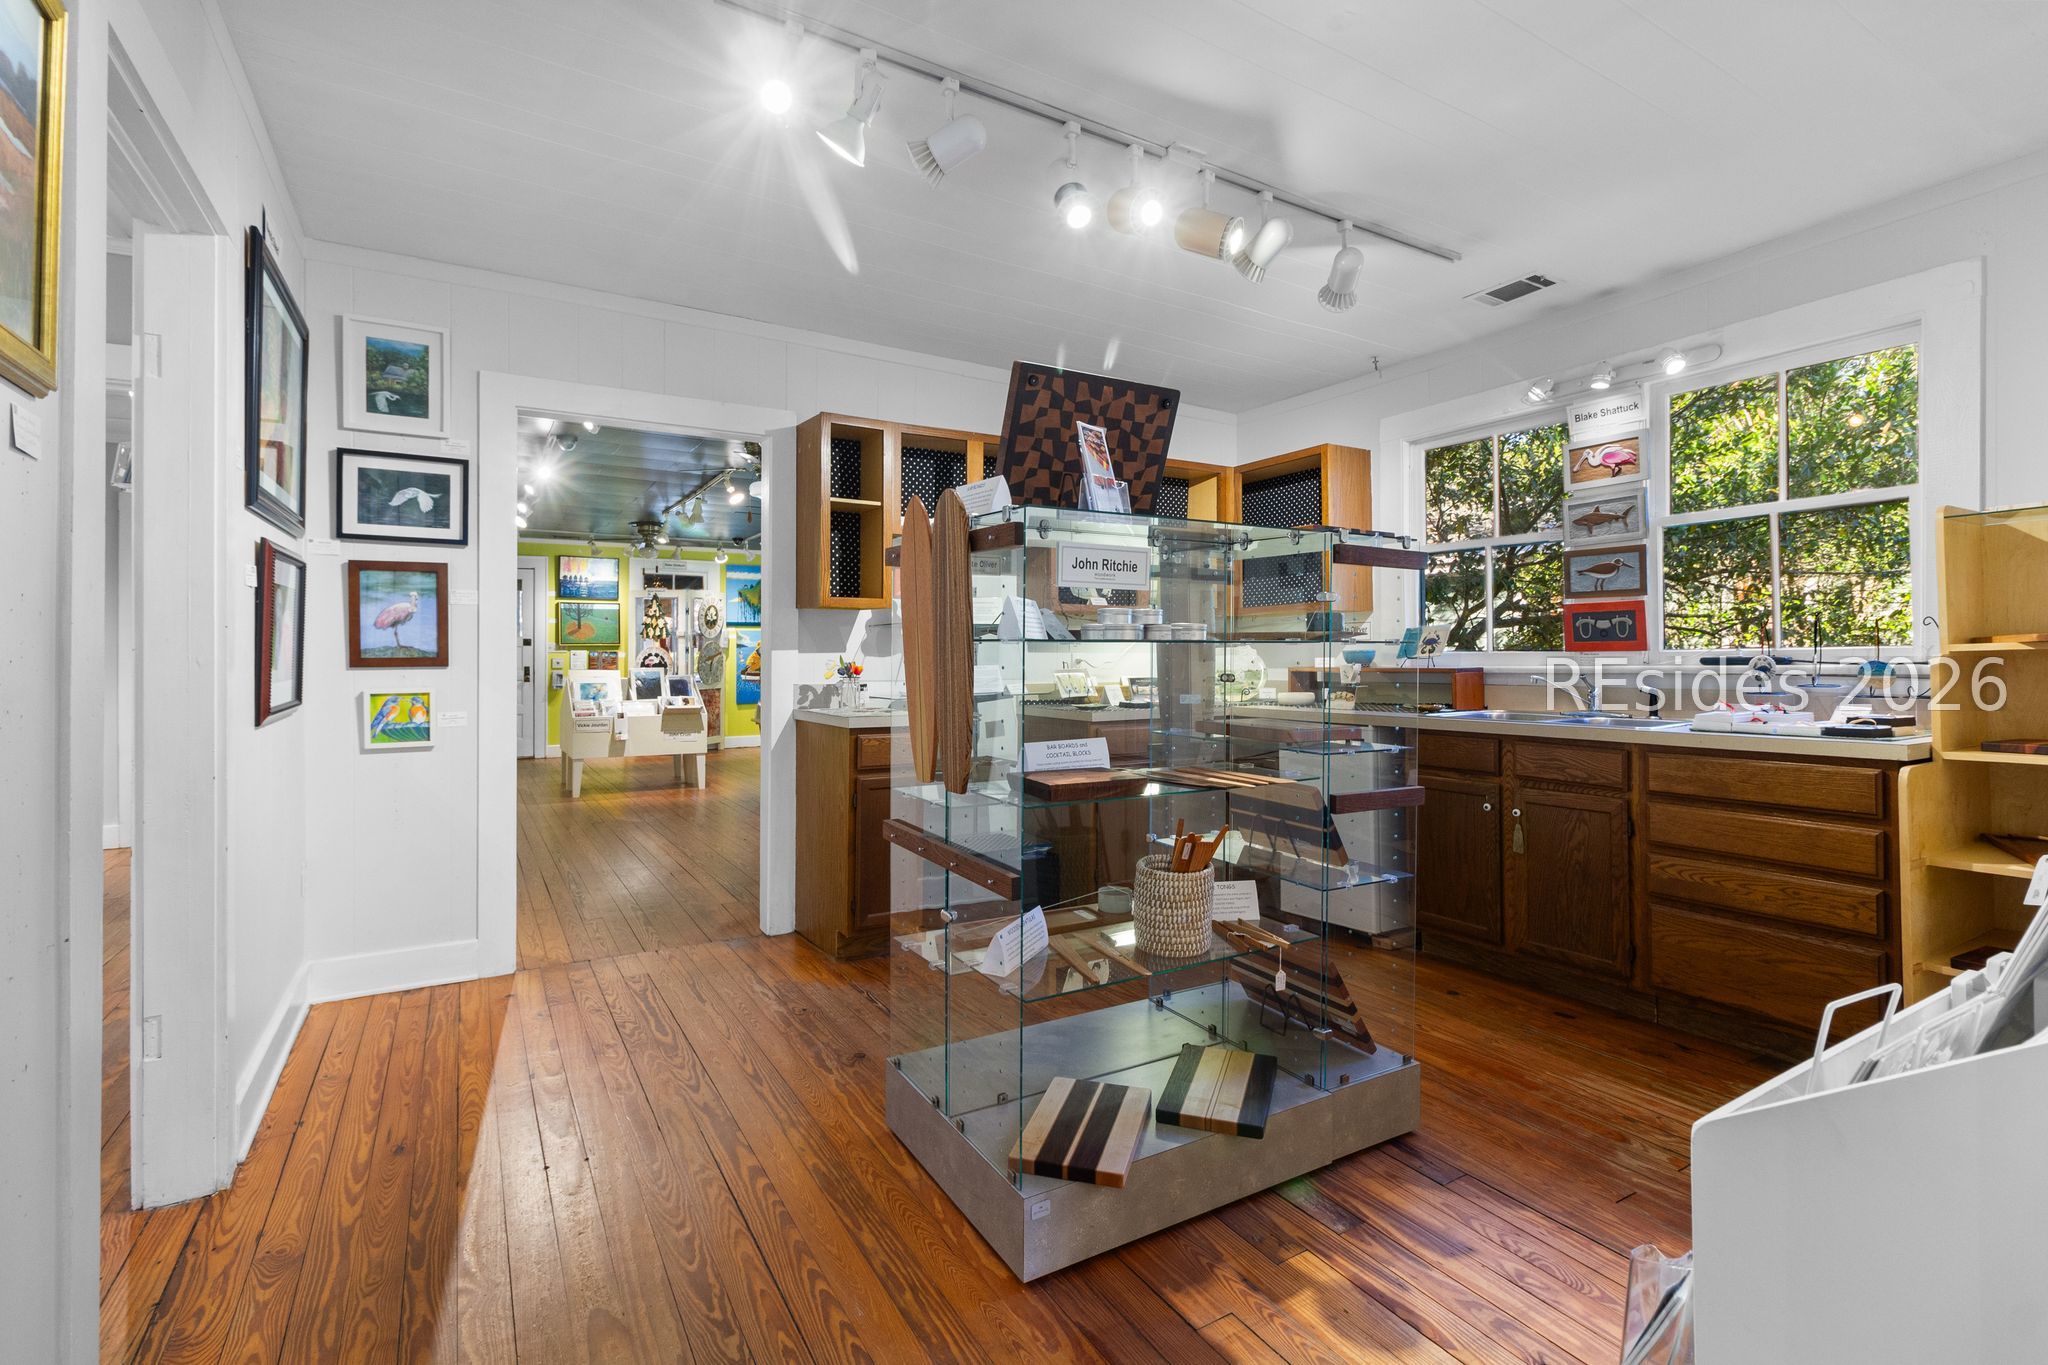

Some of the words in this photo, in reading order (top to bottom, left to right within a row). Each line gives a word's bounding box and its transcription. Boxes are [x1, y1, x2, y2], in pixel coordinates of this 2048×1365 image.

[1574, 411, 1598, 423] Blake
[1600, 401, 1640, 417] Shattuck
[979, 559, 998, 569] Oliver
[1071, 556, 1099, 571] John
[1102, 558, 1138, 573] Ritchie
[1058, 742, 1079, 750] BOARDS
[1045, 751, 1072, 759] COCKTAIL
[1072, 749, 1092, 757] BLOCKS
